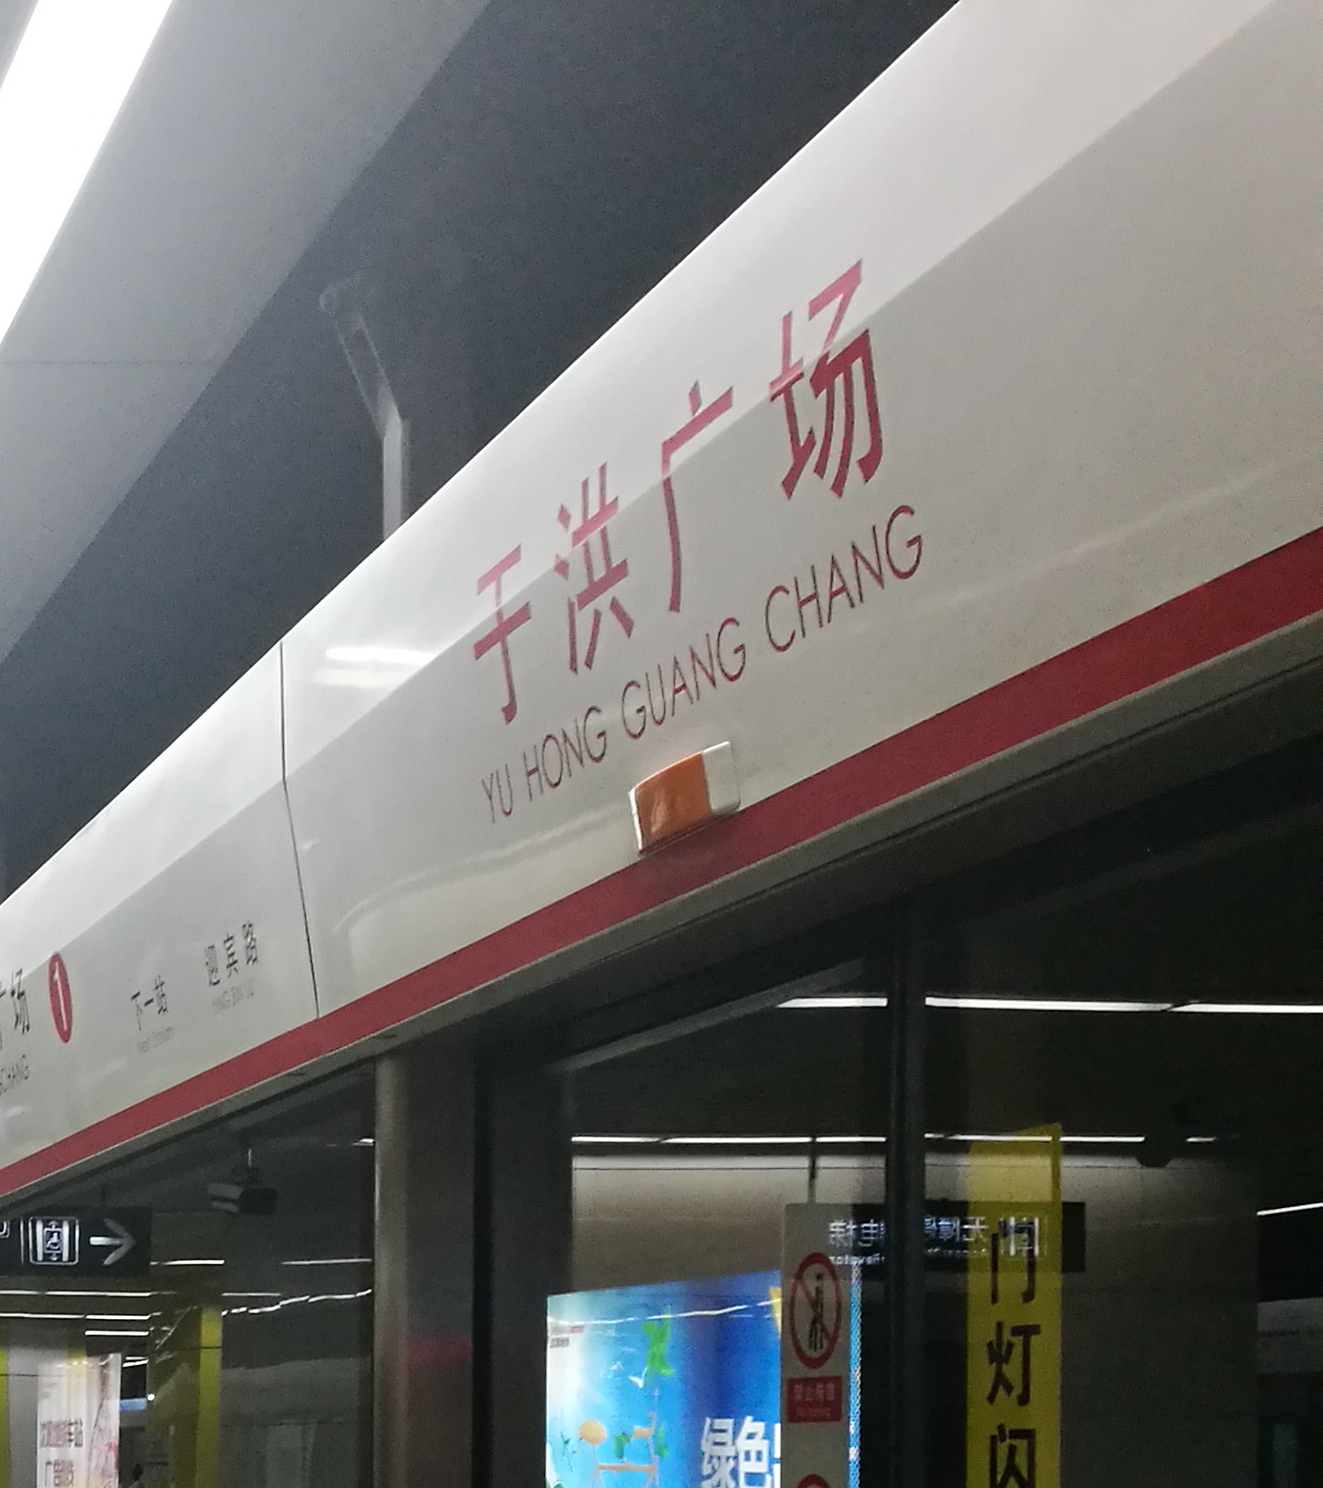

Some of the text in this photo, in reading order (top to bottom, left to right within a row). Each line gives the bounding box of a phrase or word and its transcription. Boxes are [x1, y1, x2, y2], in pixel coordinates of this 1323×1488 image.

[473, 258, 883, 724] 于洪广场
[482, 505, 923, 823] YU HONG GUANG CHANG
[131, 975, 168, 1031] 下一站
